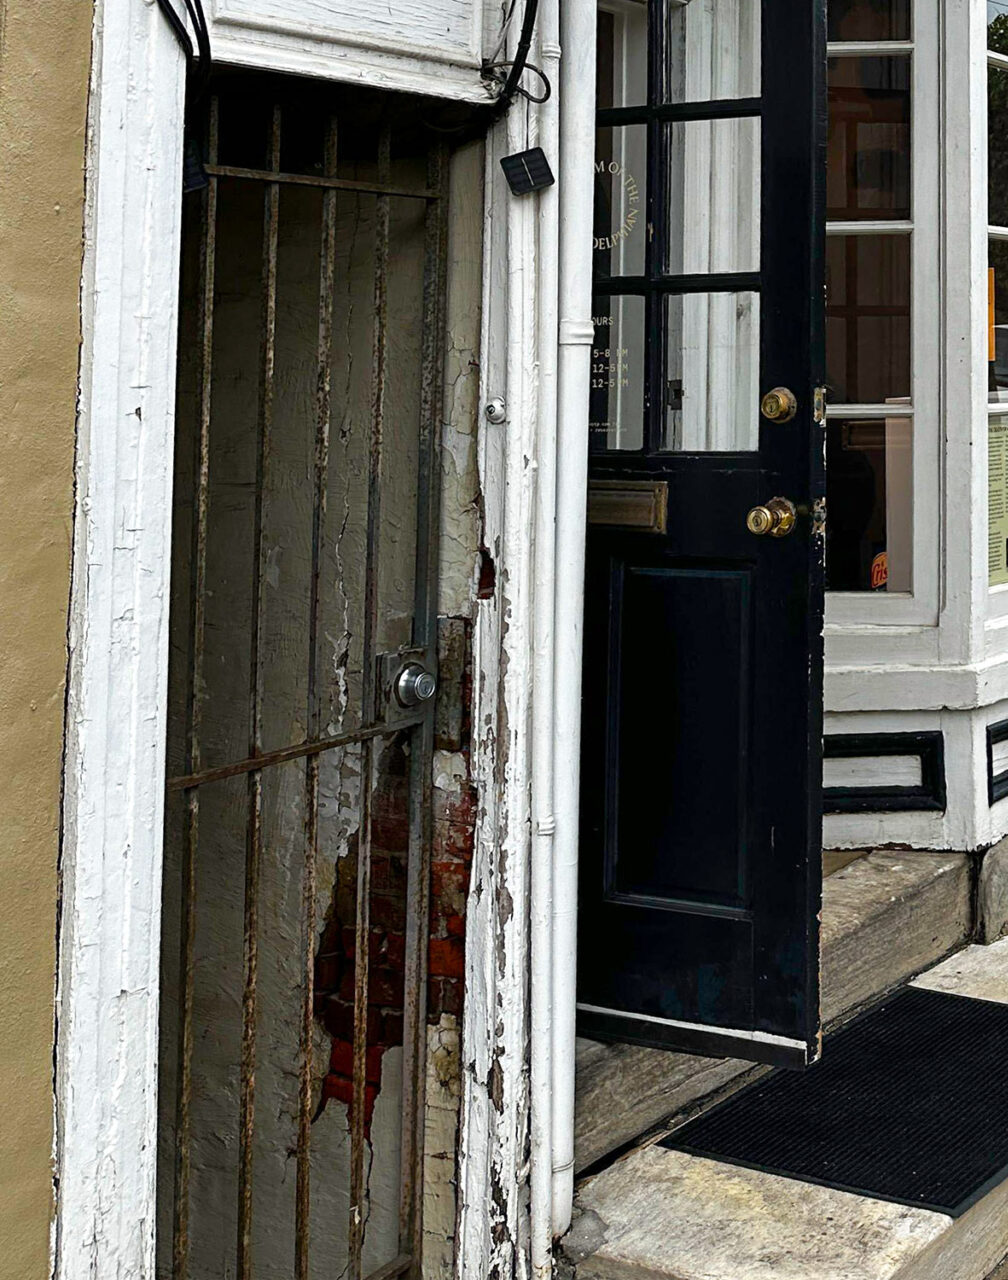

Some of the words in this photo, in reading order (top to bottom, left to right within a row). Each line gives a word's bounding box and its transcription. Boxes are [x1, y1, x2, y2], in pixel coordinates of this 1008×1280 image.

[624, 174, 640, 205] THE
[592, 316, 615, 326] OURS
[592, 364, 616, 373] 12-5
[592, 379, 615, 388] 12-5
